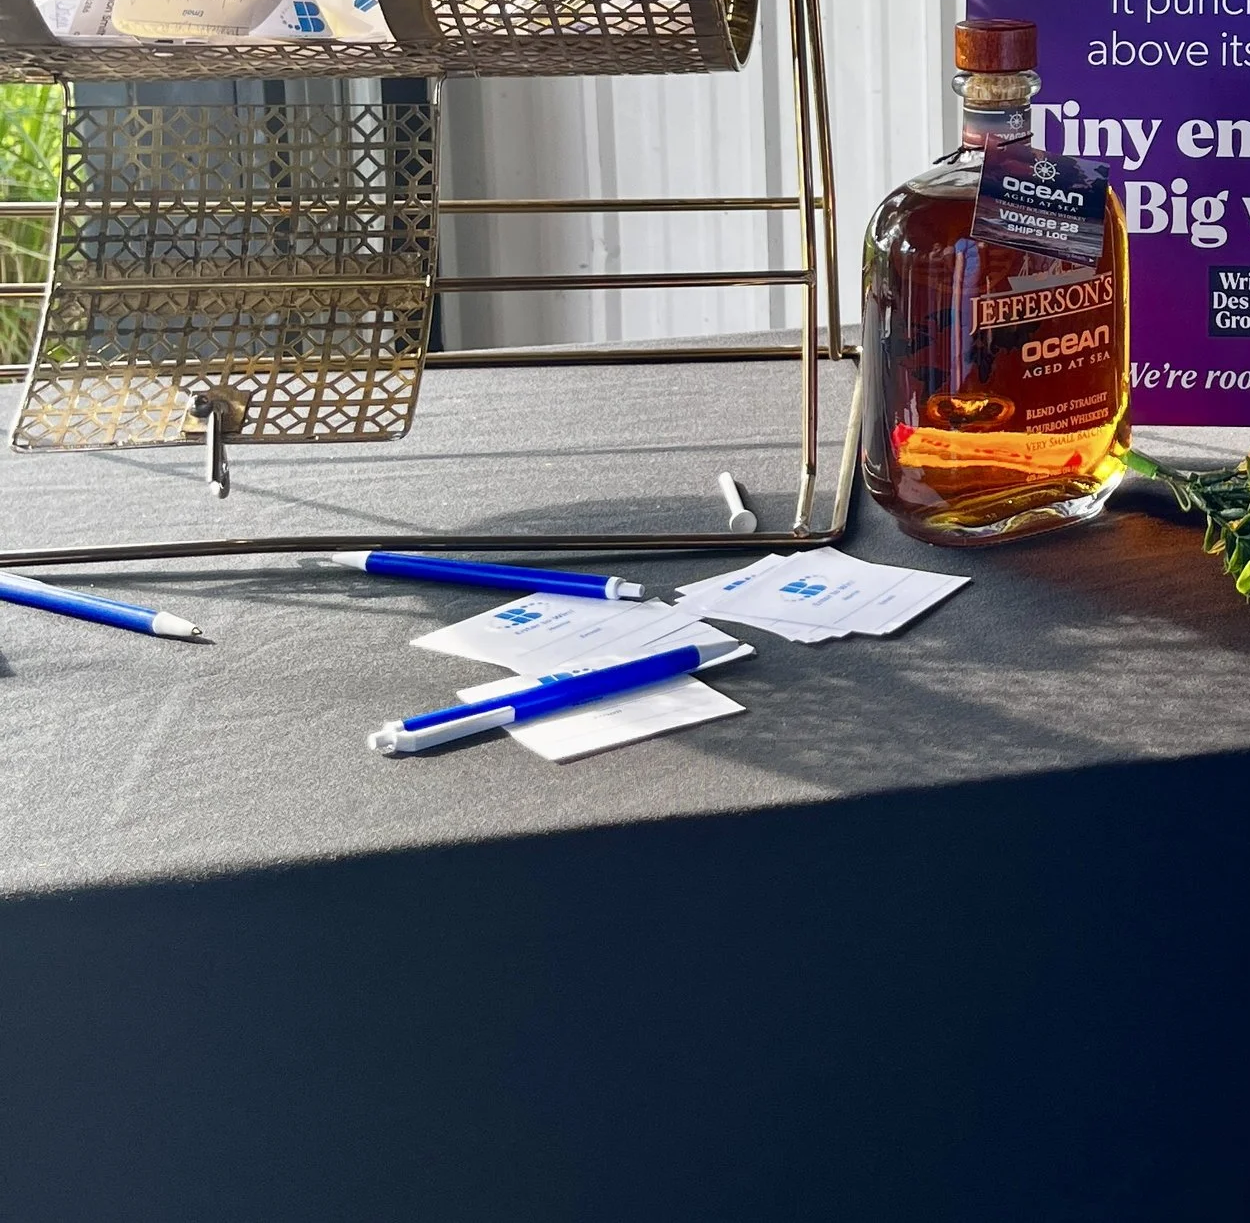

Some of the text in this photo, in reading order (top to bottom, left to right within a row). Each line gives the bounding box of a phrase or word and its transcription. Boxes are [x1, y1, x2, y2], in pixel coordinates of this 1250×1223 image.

[1087, 30, 1209, 67] above
[1030, 100, 1162, 170] Tiny
[1004, 192, 1034, 204] AGED
[1039, 200, 1052, 208] AT
[1124, 178, 1228, 248] Big
[1007, 223, 1067, 240] SHIP'S LOG
[1060, 221, 1079, 233] 28
[969, 276, 1113, 336] JEFFERSON'S
[1023, 351, 1111, 379] AGED AT SEA
[1026, 392, 1108, 420] BLEND OF STRAIGHT
[1026, 419, 1068, 435] BOURBON
[1026, 440, 1047, 452] VERY
[1050, 433, 1075, 448] SMALL
